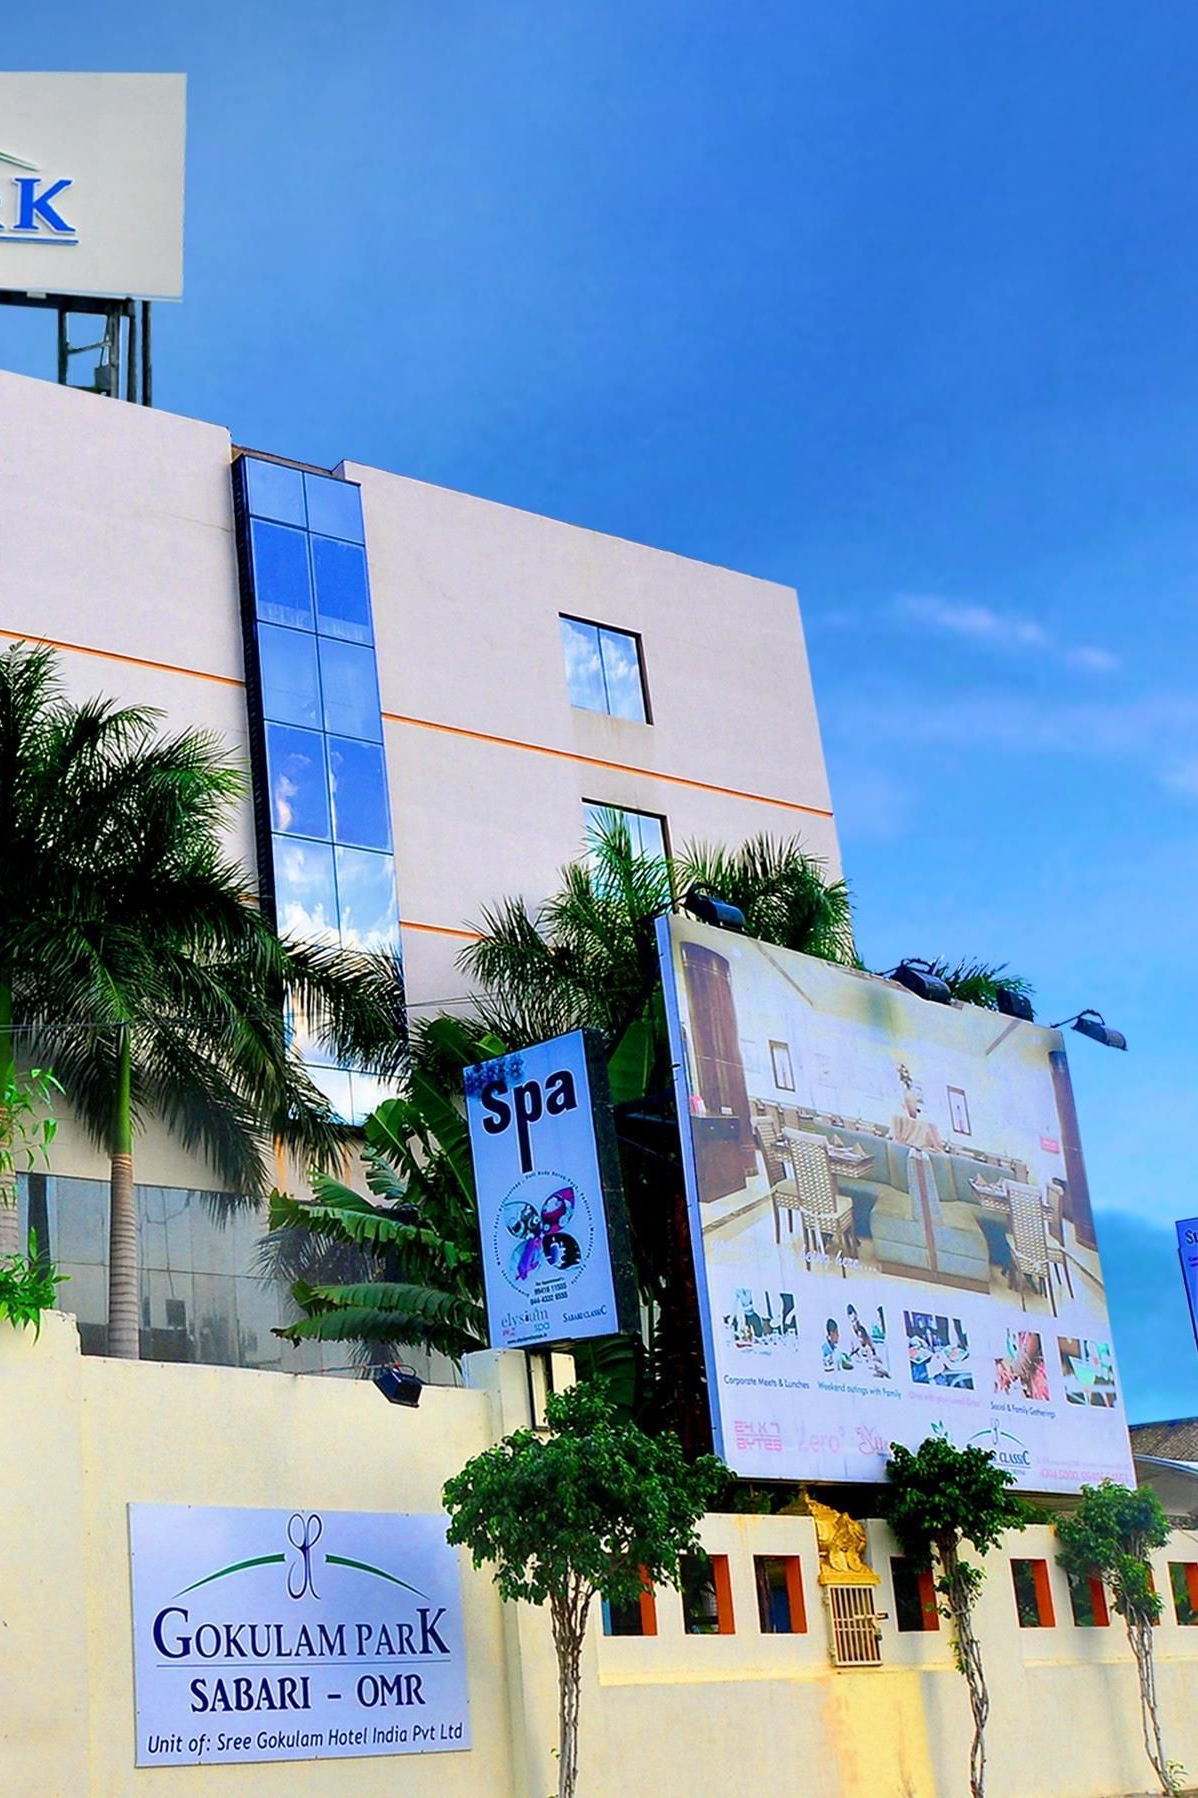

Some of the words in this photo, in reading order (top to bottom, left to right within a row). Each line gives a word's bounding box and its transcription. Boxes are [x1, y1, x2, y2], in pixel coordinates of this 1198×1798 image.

[480, 1069, 579, 1175] Spa
[723, 1374, 756, 1386] Corporate
[784, 1379, 811, 1390] Lunches
[882, 1387, 901, 1400] Family
[152, 1606, 347, 1659] GOKULAM
[355, 1607, 451, 1656] PARK
[190, 1676, 312, 1713] SABARI
[356, 1673, 426, 1708] OMR
[147, 1736, 183, 1754] Unit
[188, 1734, 211, 1756] of:
[217, 1732, 252, 1751] Sree
[257, 1728, 324, 1750] Gokulam
[328, 1727, 368, 1747] Hotel
[372, 1725, 408, 1745] India
[413, 1724, 436, 1742] Pvt
[440, 1722, 463, 1740] Ltd
